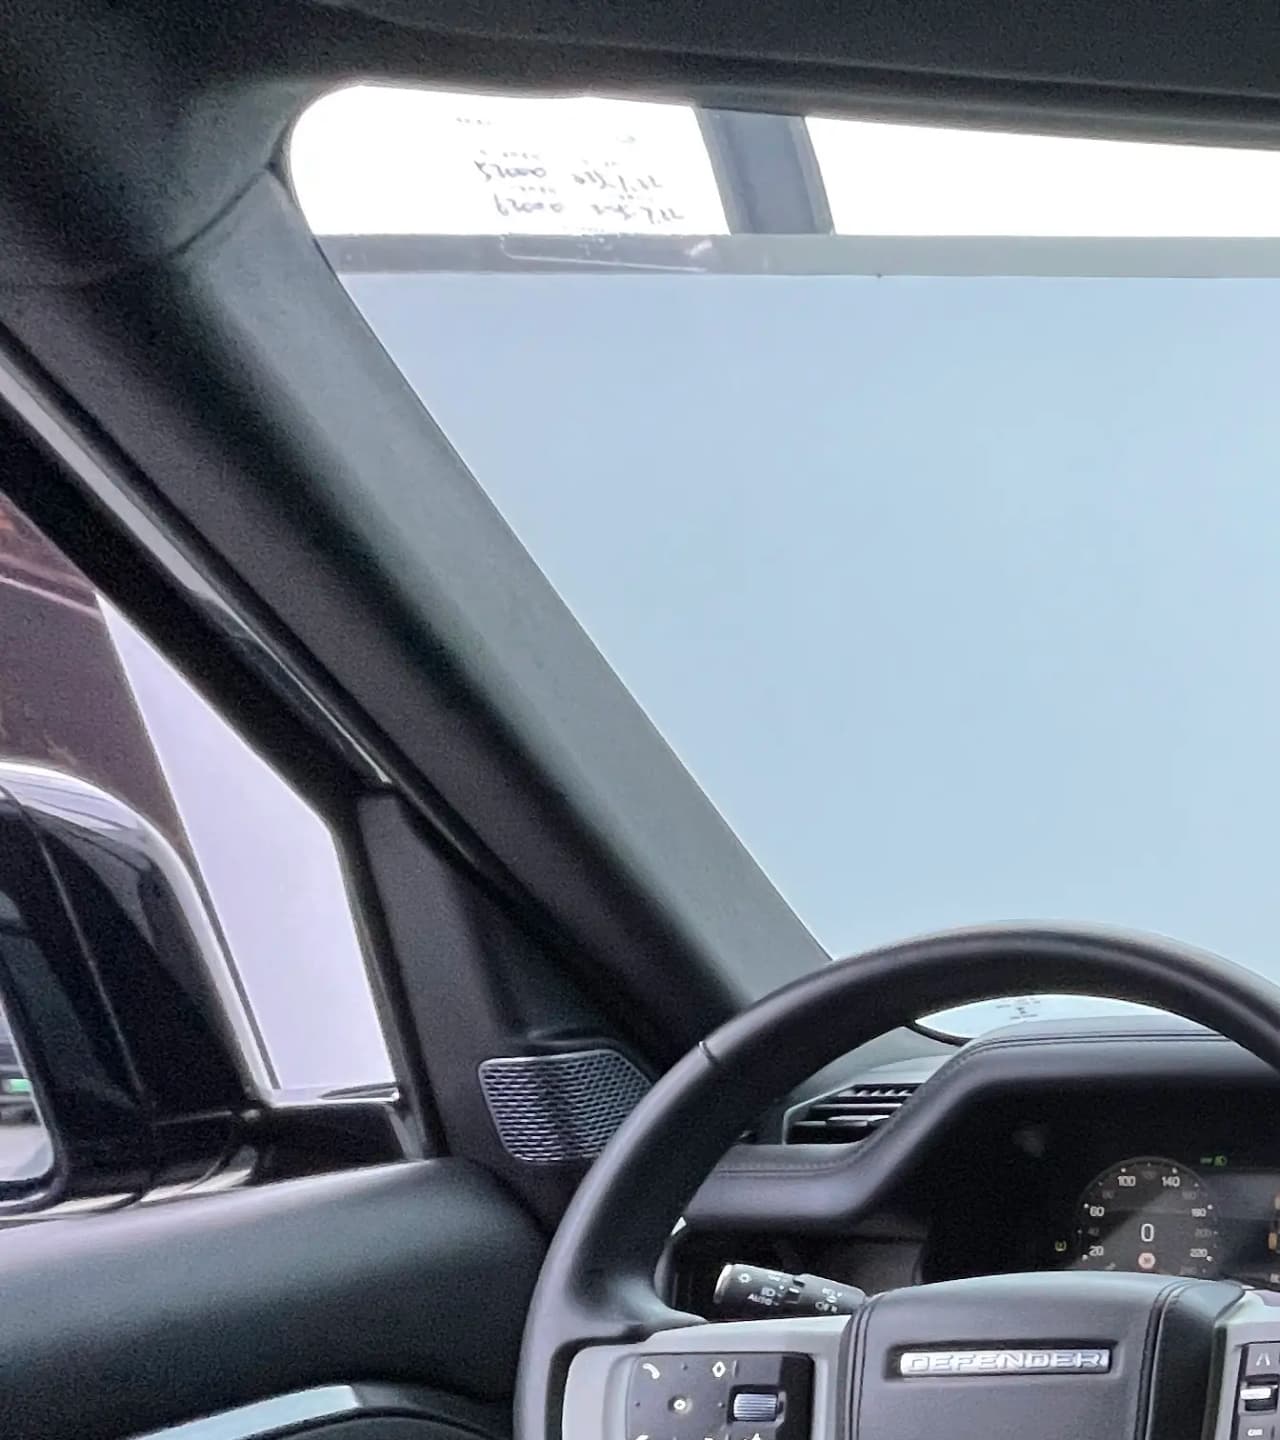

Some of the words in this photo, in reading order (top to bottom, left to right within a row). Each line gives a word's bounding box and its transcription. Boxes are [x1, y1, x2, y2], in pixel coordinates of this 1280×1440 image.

[1117, 1175, 1137, 1187] 100
[1161, 1176, 1181, 1188] 140
[1140, 1223, 1155, 1242] 0
[1089, 1245, 1105, 1256] 20
[908, 1351, 1102, 1373] DEFENDER
